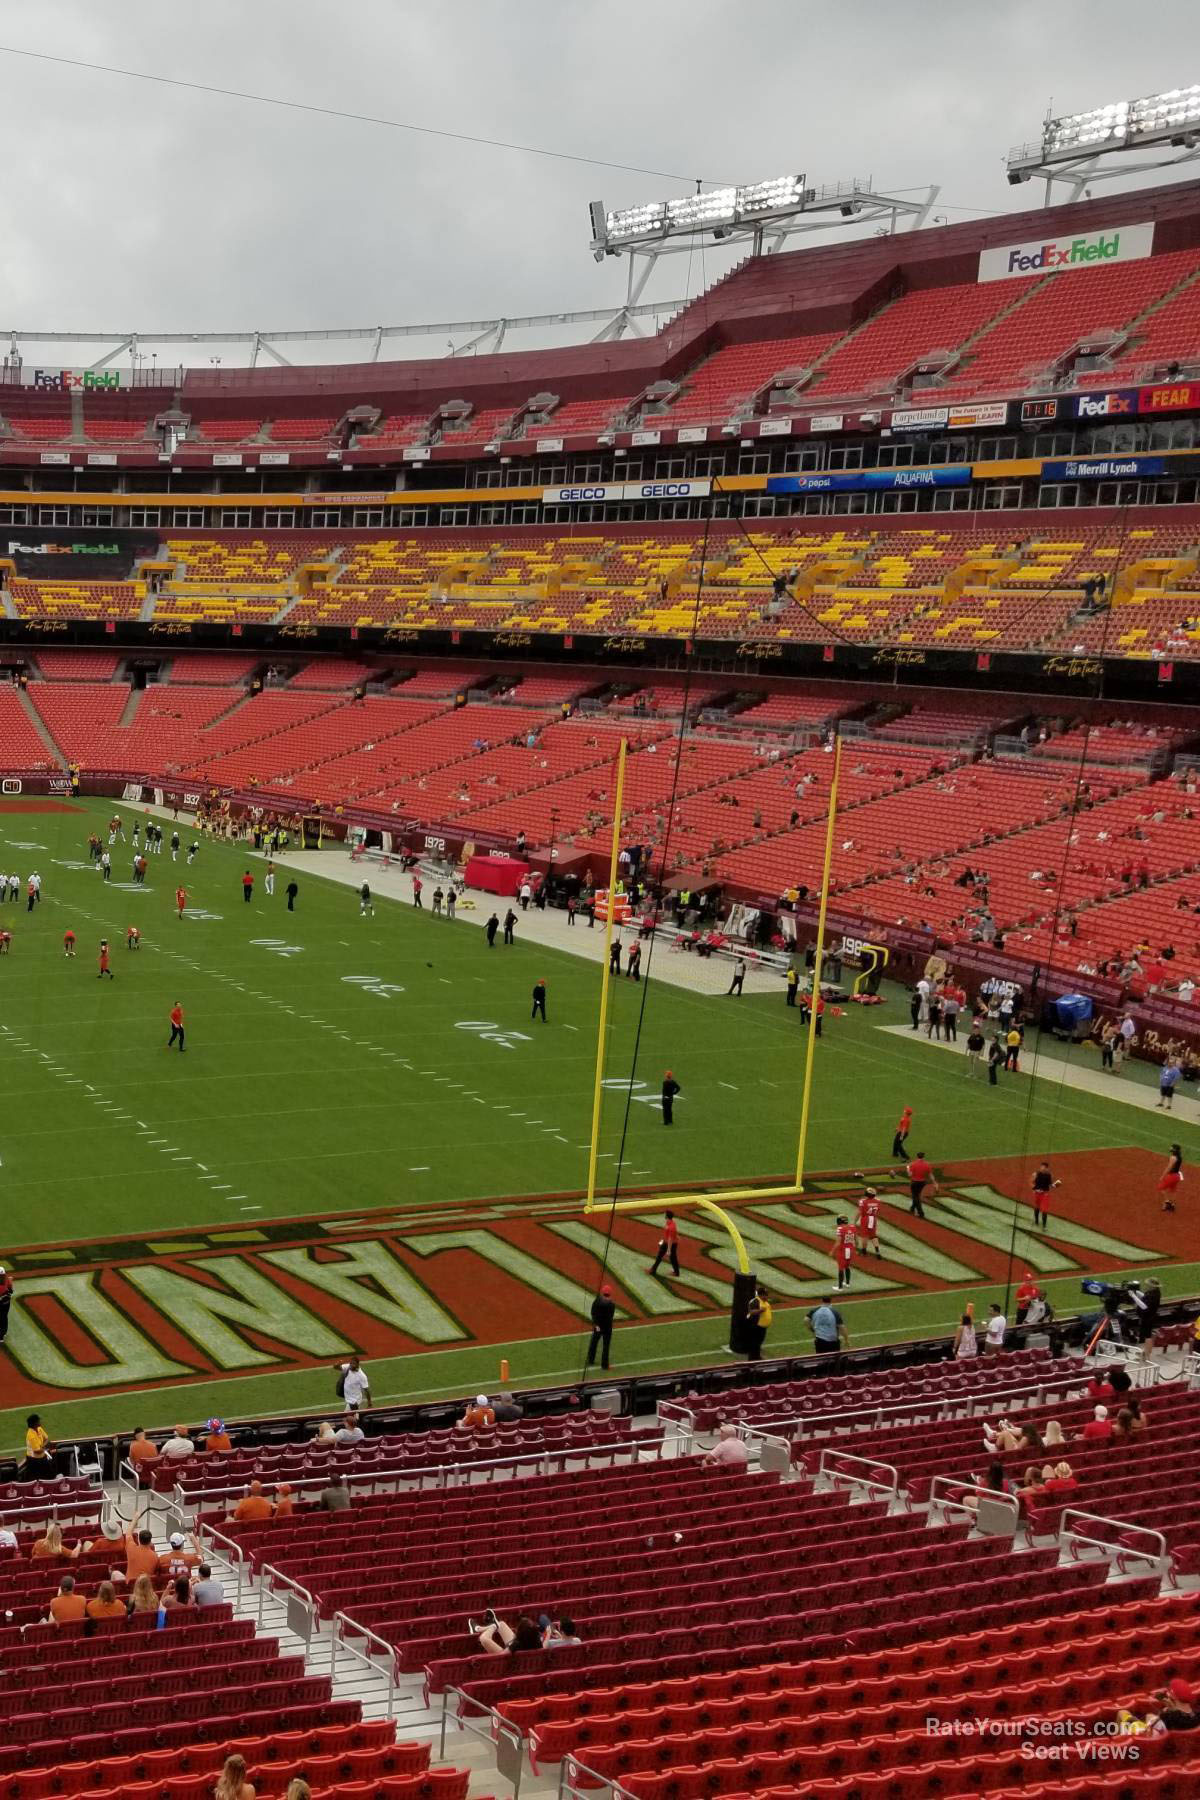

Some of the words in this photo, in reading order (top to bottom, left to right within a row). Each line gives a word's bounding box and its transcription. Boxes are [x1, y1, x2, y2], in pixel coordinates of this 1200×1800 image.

[1008, 233, 1120, 273] FedExField
[34, 370, 119, 387] FedExField
[1078, 393, 1131, 416] FedEx
[1078, 463, 1108, 476] Merrill
[1109, 461, 1138, 474] Lynch
[808, 477, 831, 489] pepsi
[894, 471, 936, 486] AQUAFINA
[559, 487, 606, 500] GEICO
[642, 484, 691, 497] GEICO
[8, 541, 120, 555] FedExField
[5, 780, 19, 792] 40
[183, 792, 200, 805] 1937
[424, 835, 446, 851] 1972
[248, 938, 305, 953] 40
[340, 975, 406, 994] 30
[453, 1020, 534, 1043] 20
